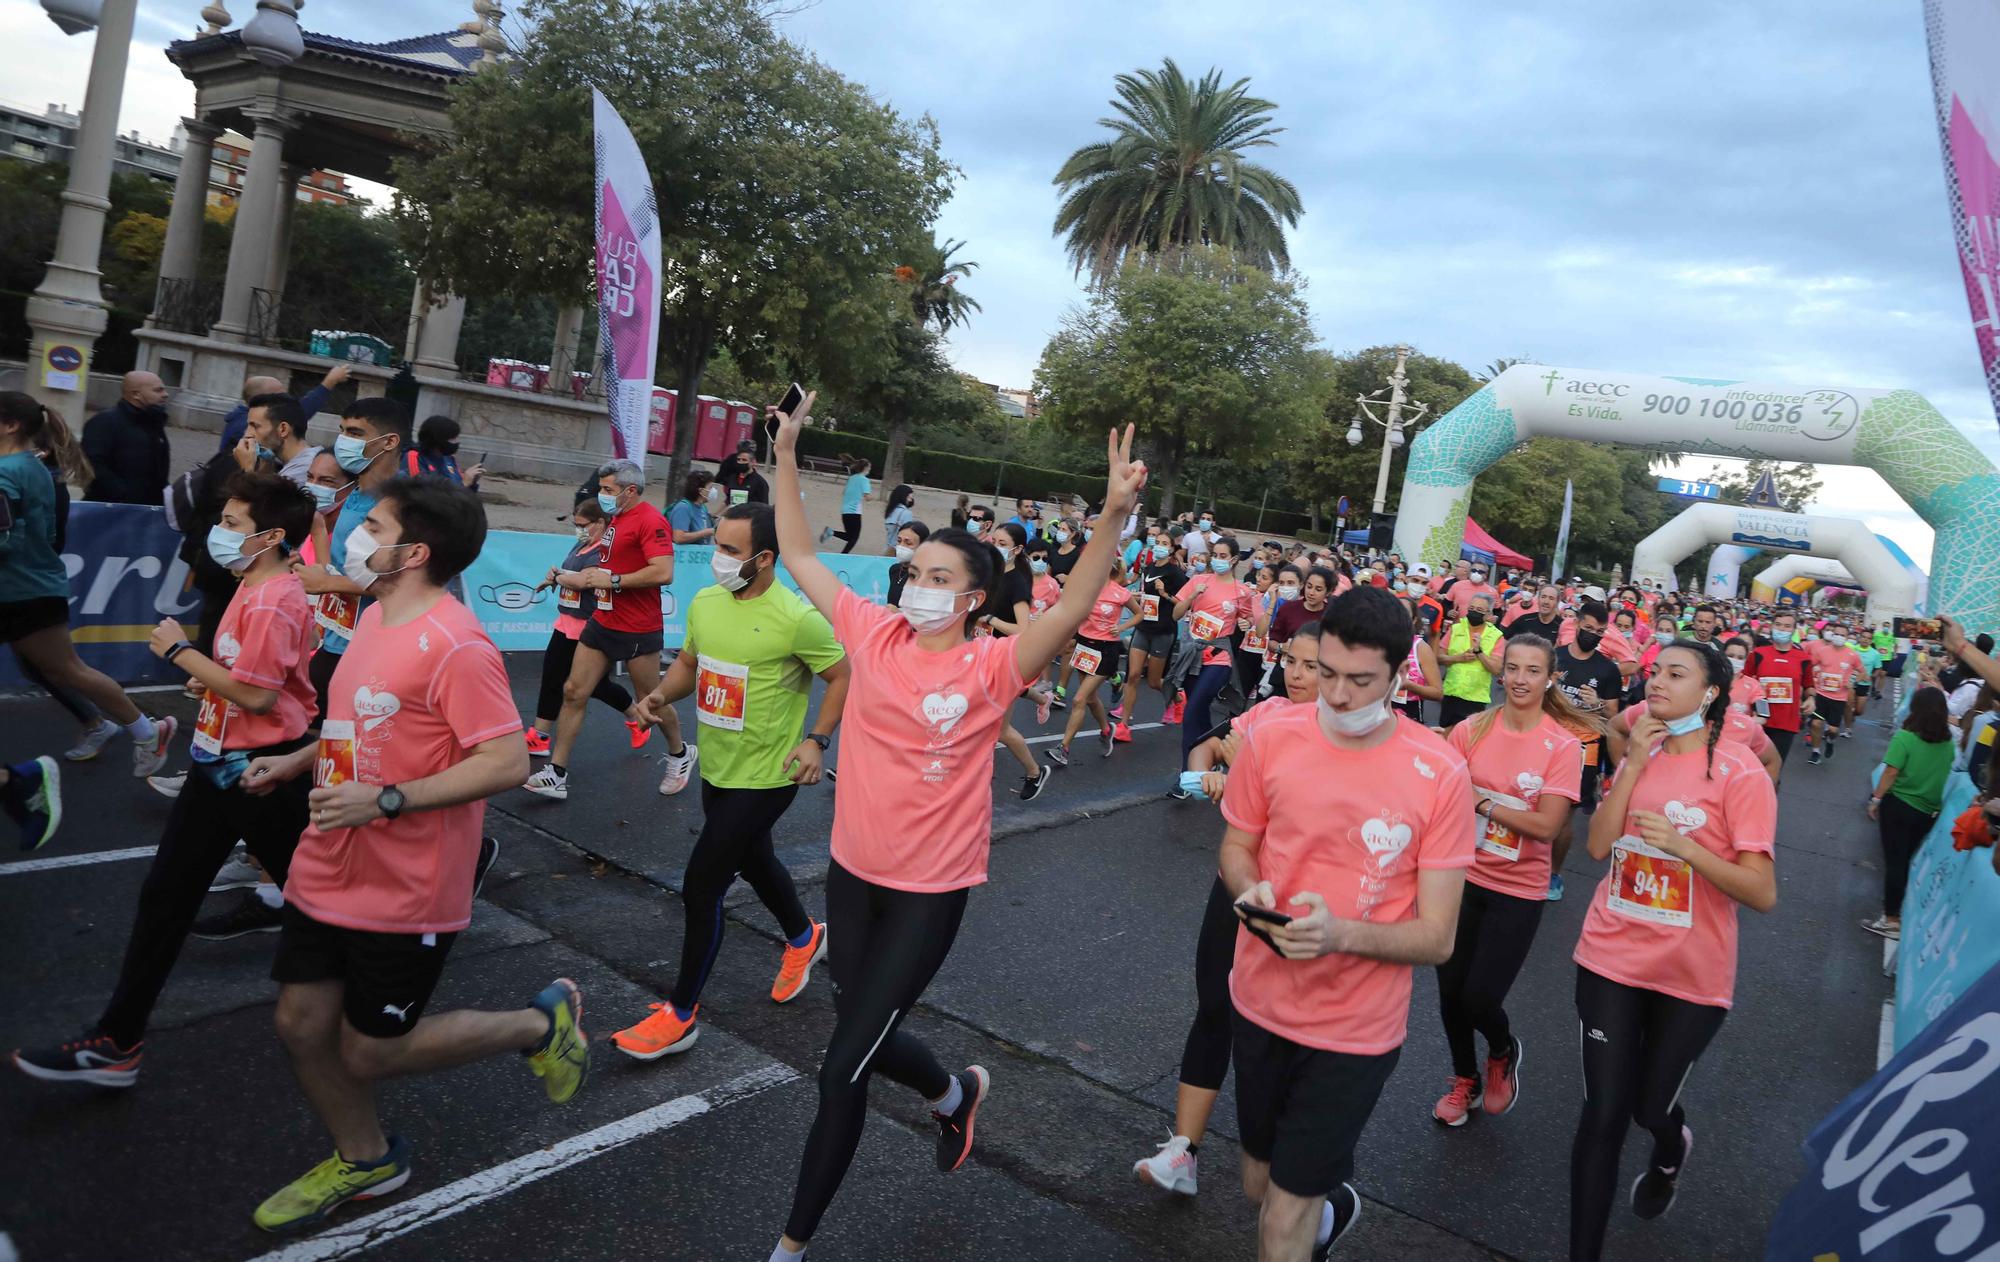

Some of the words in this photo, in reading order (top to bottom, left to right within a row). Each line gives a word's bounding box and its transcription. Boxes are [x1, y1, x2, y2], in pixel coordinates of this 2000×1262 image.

[1566, 380, 1630, 397] aecc
[1726, 390, 1807, 404] infocáncer
[1815, 393, 1835, 402] 24
[1568, 404, 1583, 417] Es
[1587, 406, 1622, 421] Vida.
[1643, 394, 1691, 415] 900
[1700, 399, 1746, 420] 100
[1752, 402, 1804, 424] 036
[1828, 411, 1843, 428] 7
[705, 685, 728, 709] 811
[1366, 832, 1404, 847] aecc
[1633, 870, 1670, 901] 941
